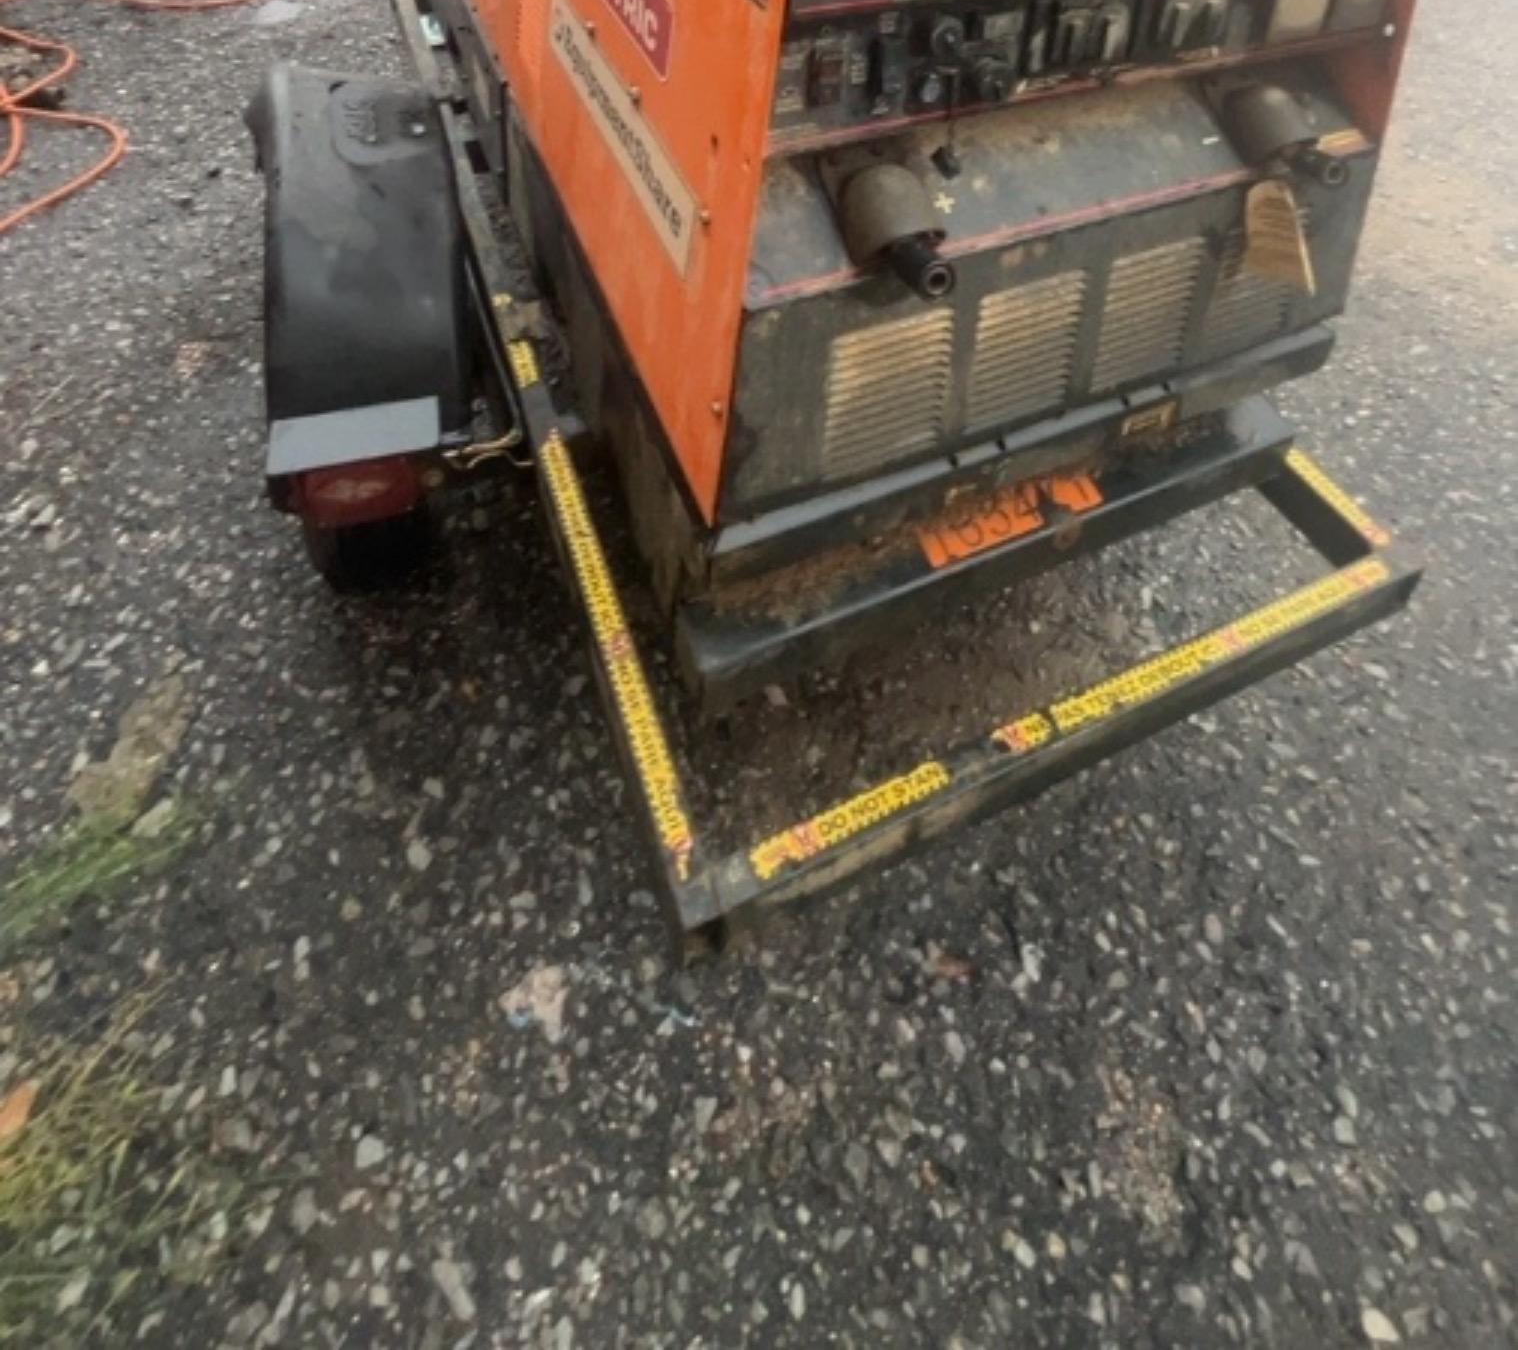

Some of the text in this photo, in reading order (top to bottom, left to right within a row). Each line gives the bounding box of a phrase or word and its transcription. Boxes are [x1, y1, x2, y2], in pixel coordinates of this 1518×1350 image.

[818, 767, 940, 834] DO NOT STAN
